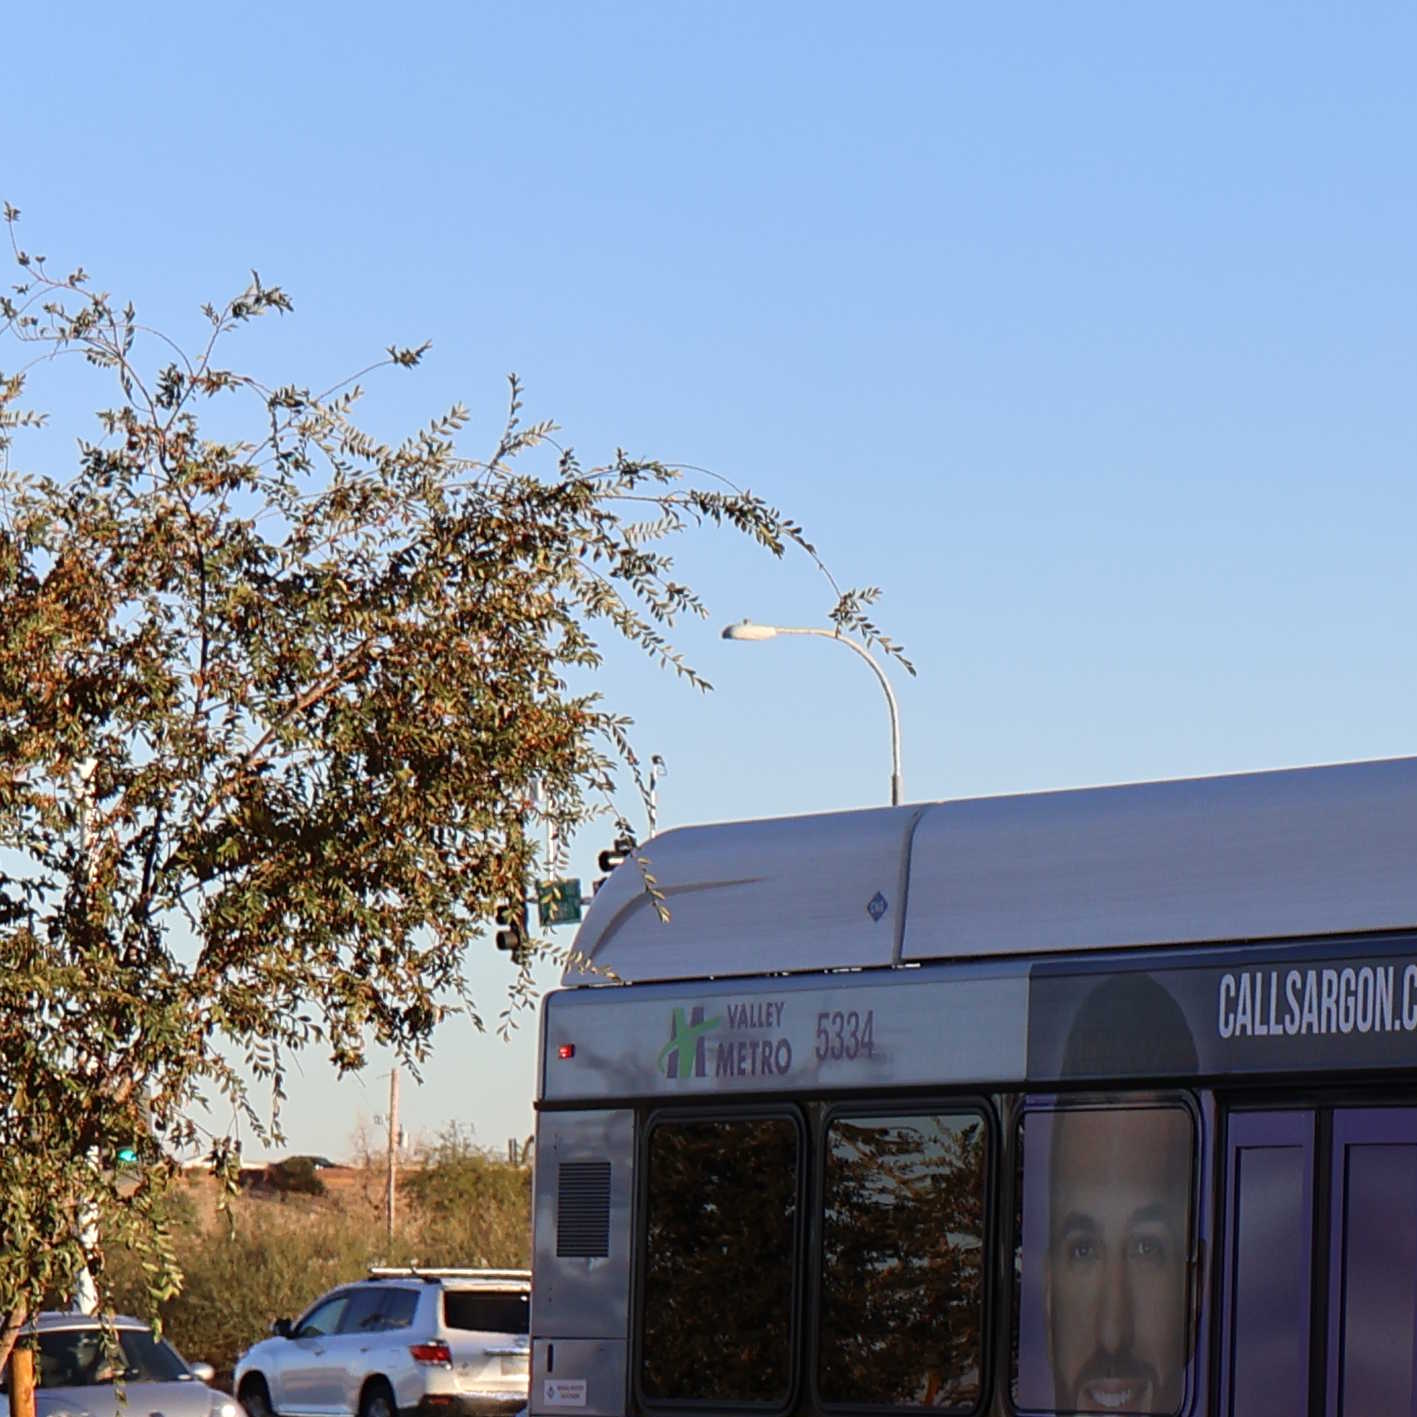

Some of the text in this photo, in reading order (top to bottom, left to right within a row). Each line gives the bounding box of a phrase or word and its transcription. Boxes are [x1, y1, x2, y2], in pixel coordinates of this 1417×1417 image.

[727, 1002, 784, 1030] VALLEY
[814, 1009, 875, 1062] 5334
[715, 1039, 792, 1078] METRO
